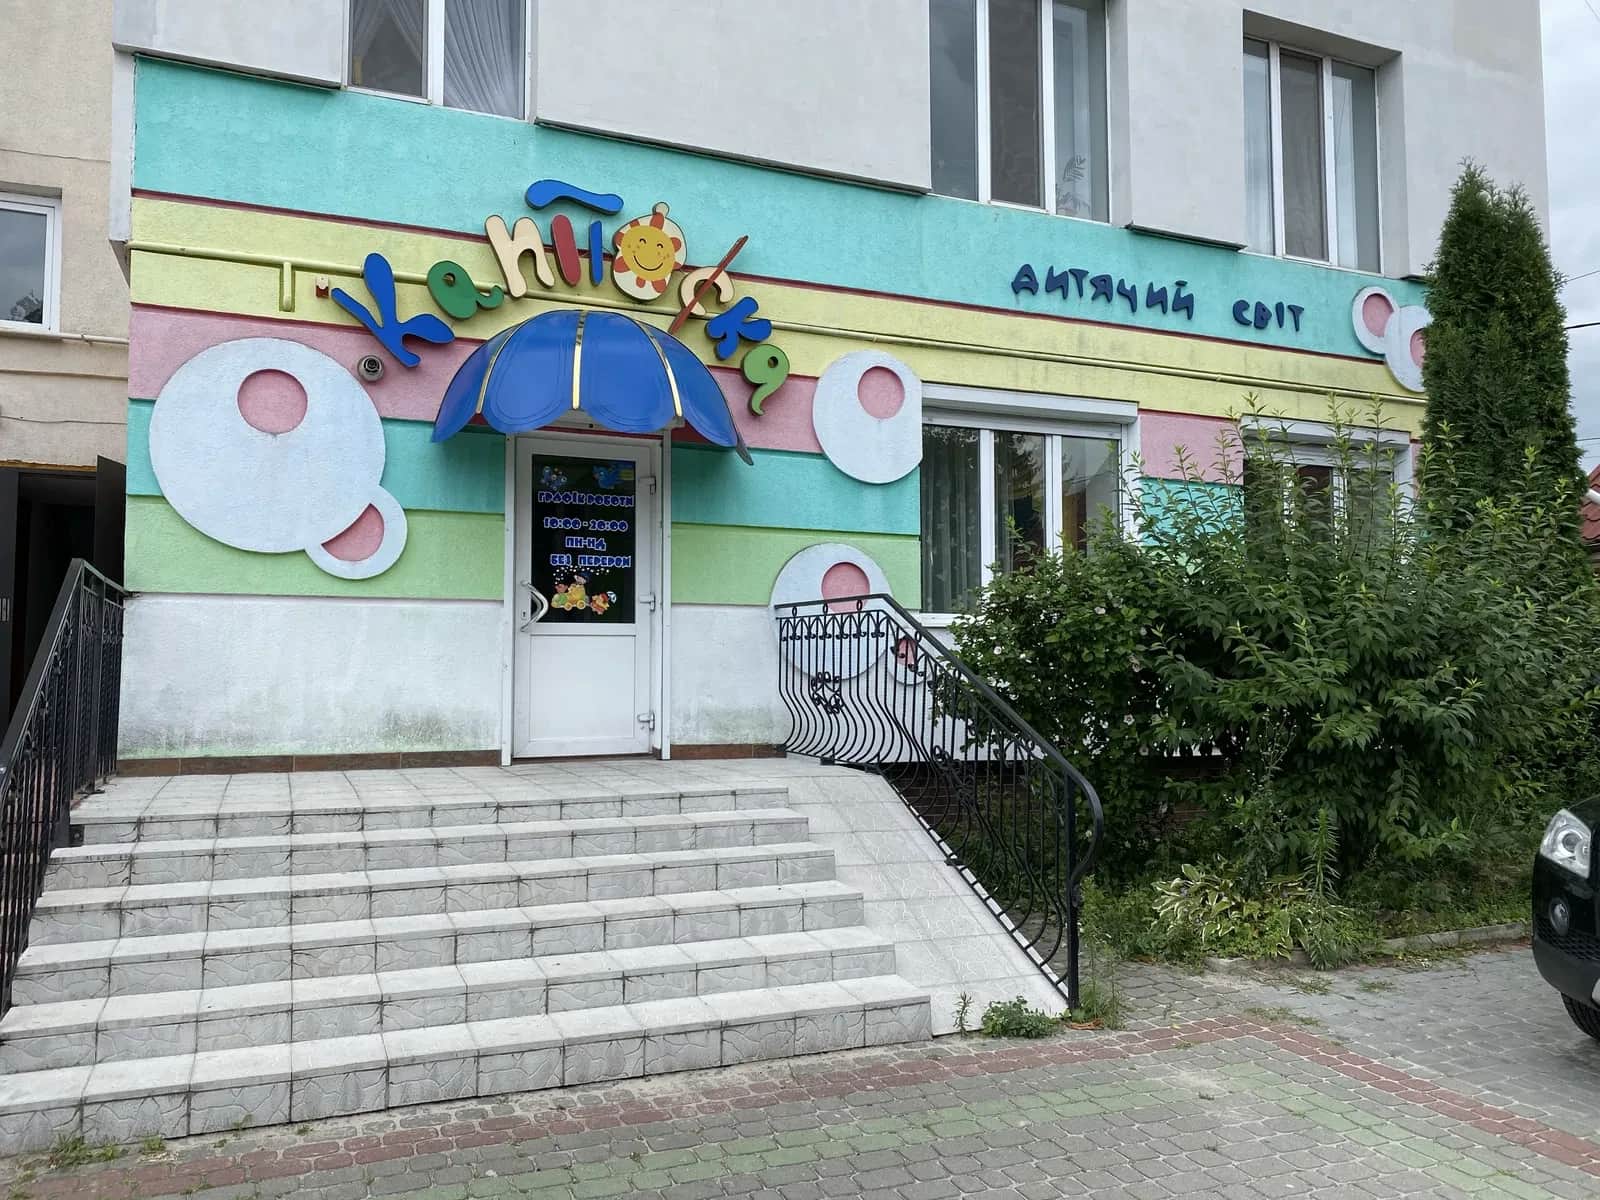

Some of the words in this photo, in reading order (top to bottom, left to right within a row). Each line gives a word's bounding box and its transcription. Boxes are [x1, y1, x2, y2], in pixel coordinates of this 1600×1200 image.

[1011, 263, 1195, 320] ДИТЯЧИЙ
[1232, 299, 1305, 332] СВІТ
[587, 494, 635, 507] РОБОТИ
[543, 516, 581, 529] 10:00
[589, 519, 628, 532] 20:00
[565, 536, 607, 551] ПН-НД
[550, 554, 573, 566] БЕЗ
